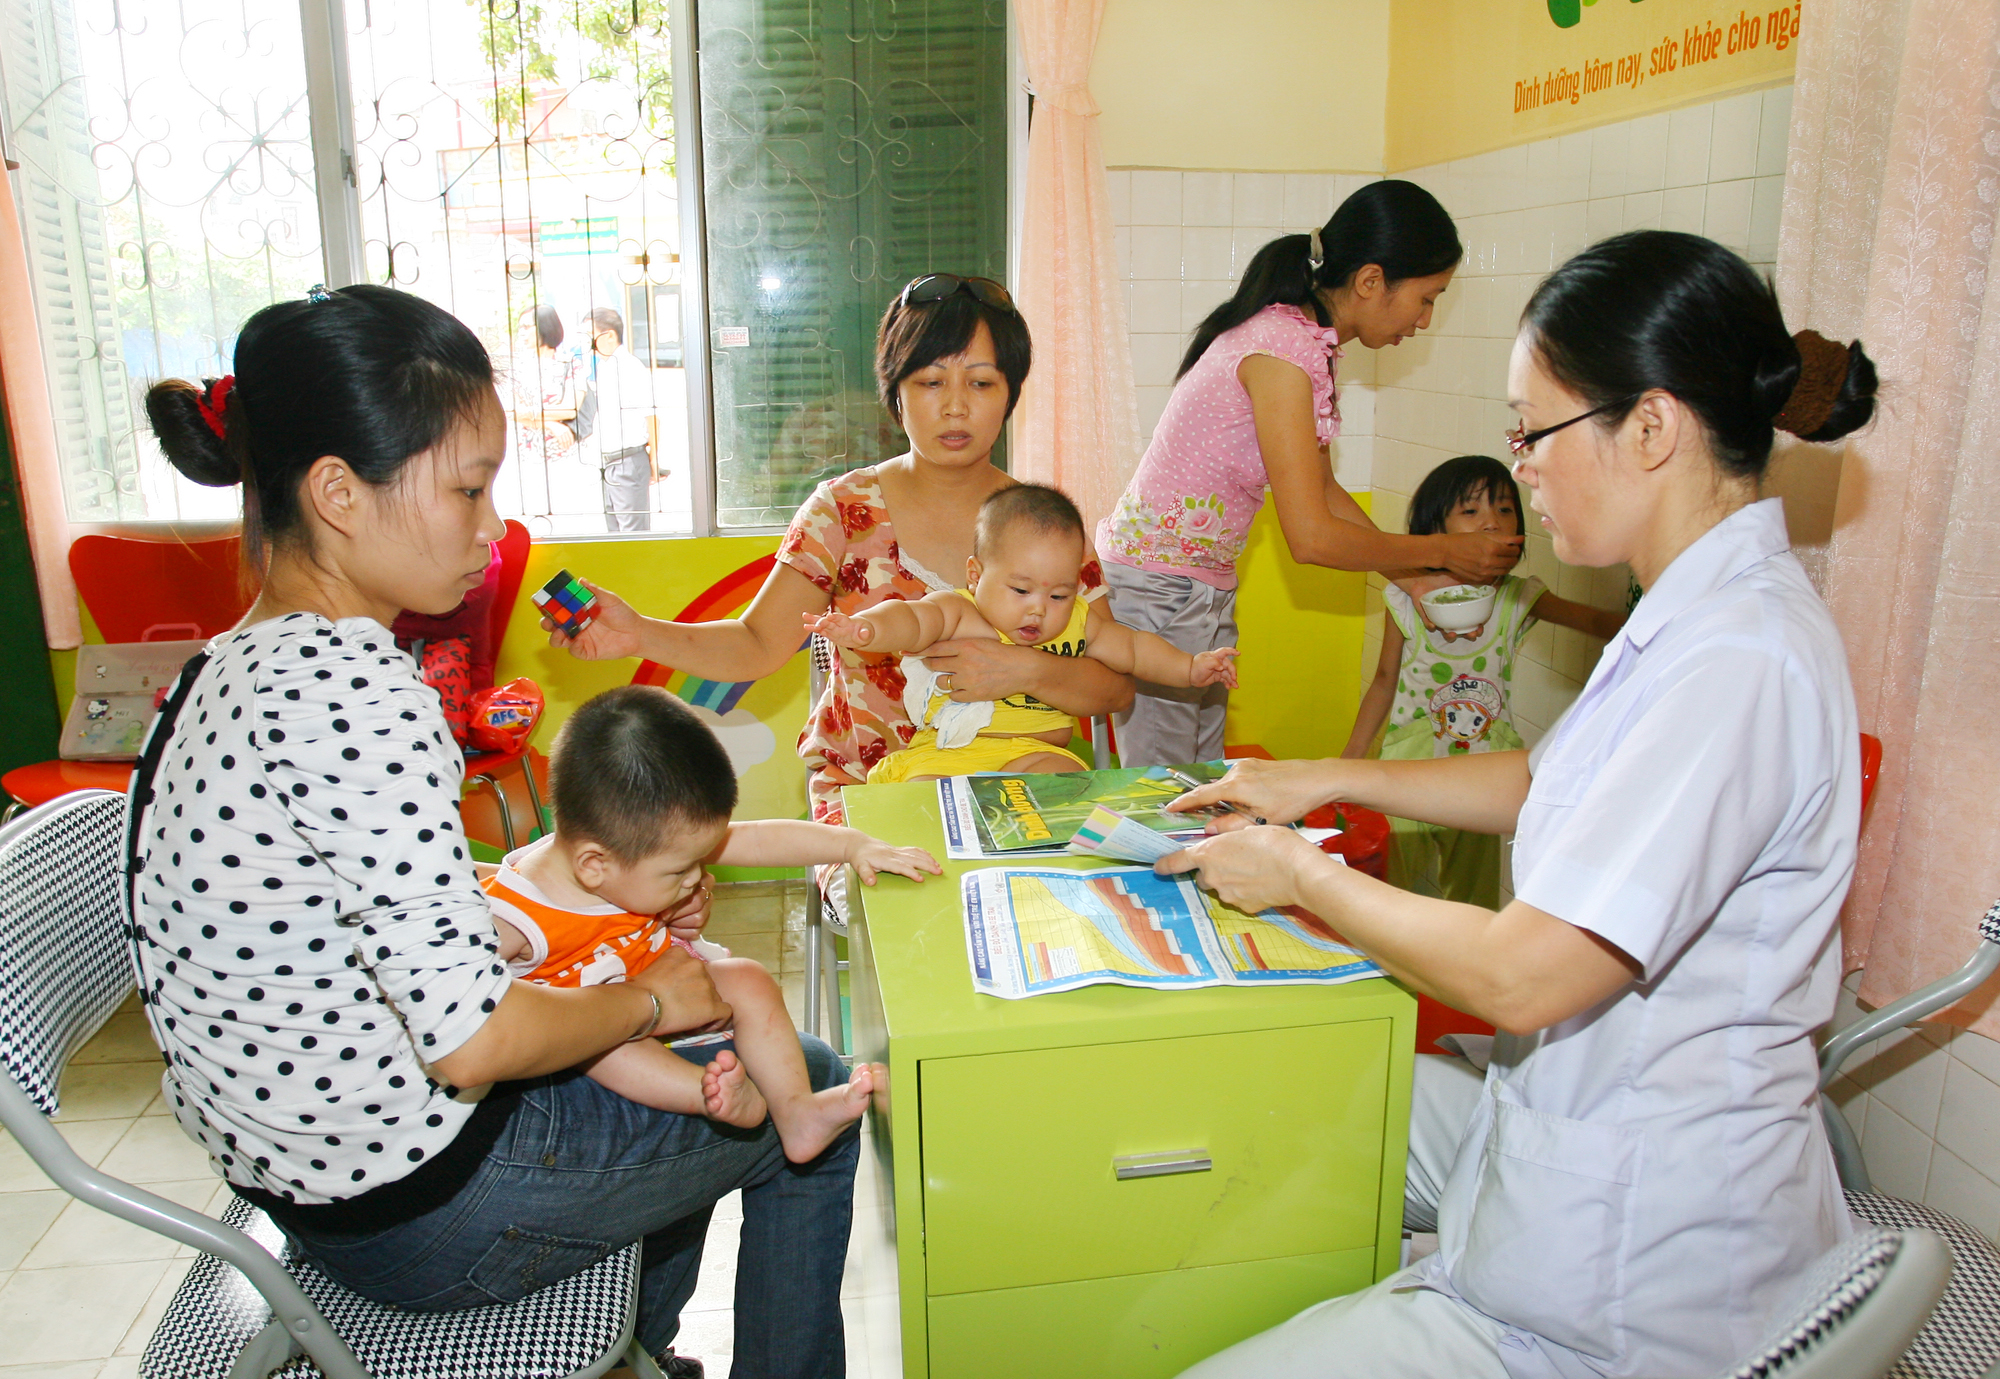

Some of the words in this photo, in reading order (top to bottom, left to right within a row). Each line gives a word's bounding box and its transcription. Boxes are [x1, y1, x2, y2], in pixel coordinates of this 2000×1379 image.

[1514, 76, 1540, 113] Dinh
[1543, 67, 1579, 105] dưỡng
[1583, 58, 1612, 95] hôm
[1616, 53, 1644, 89] nay,
[1649, 36, 1678, 76] sức
[1682, 20, 1722, 67] khỏe
[1727, 10, 1761, 55] cho
[491, 708, 516, 725] AFC
[1015, 813, 1053, 841] Dinh
